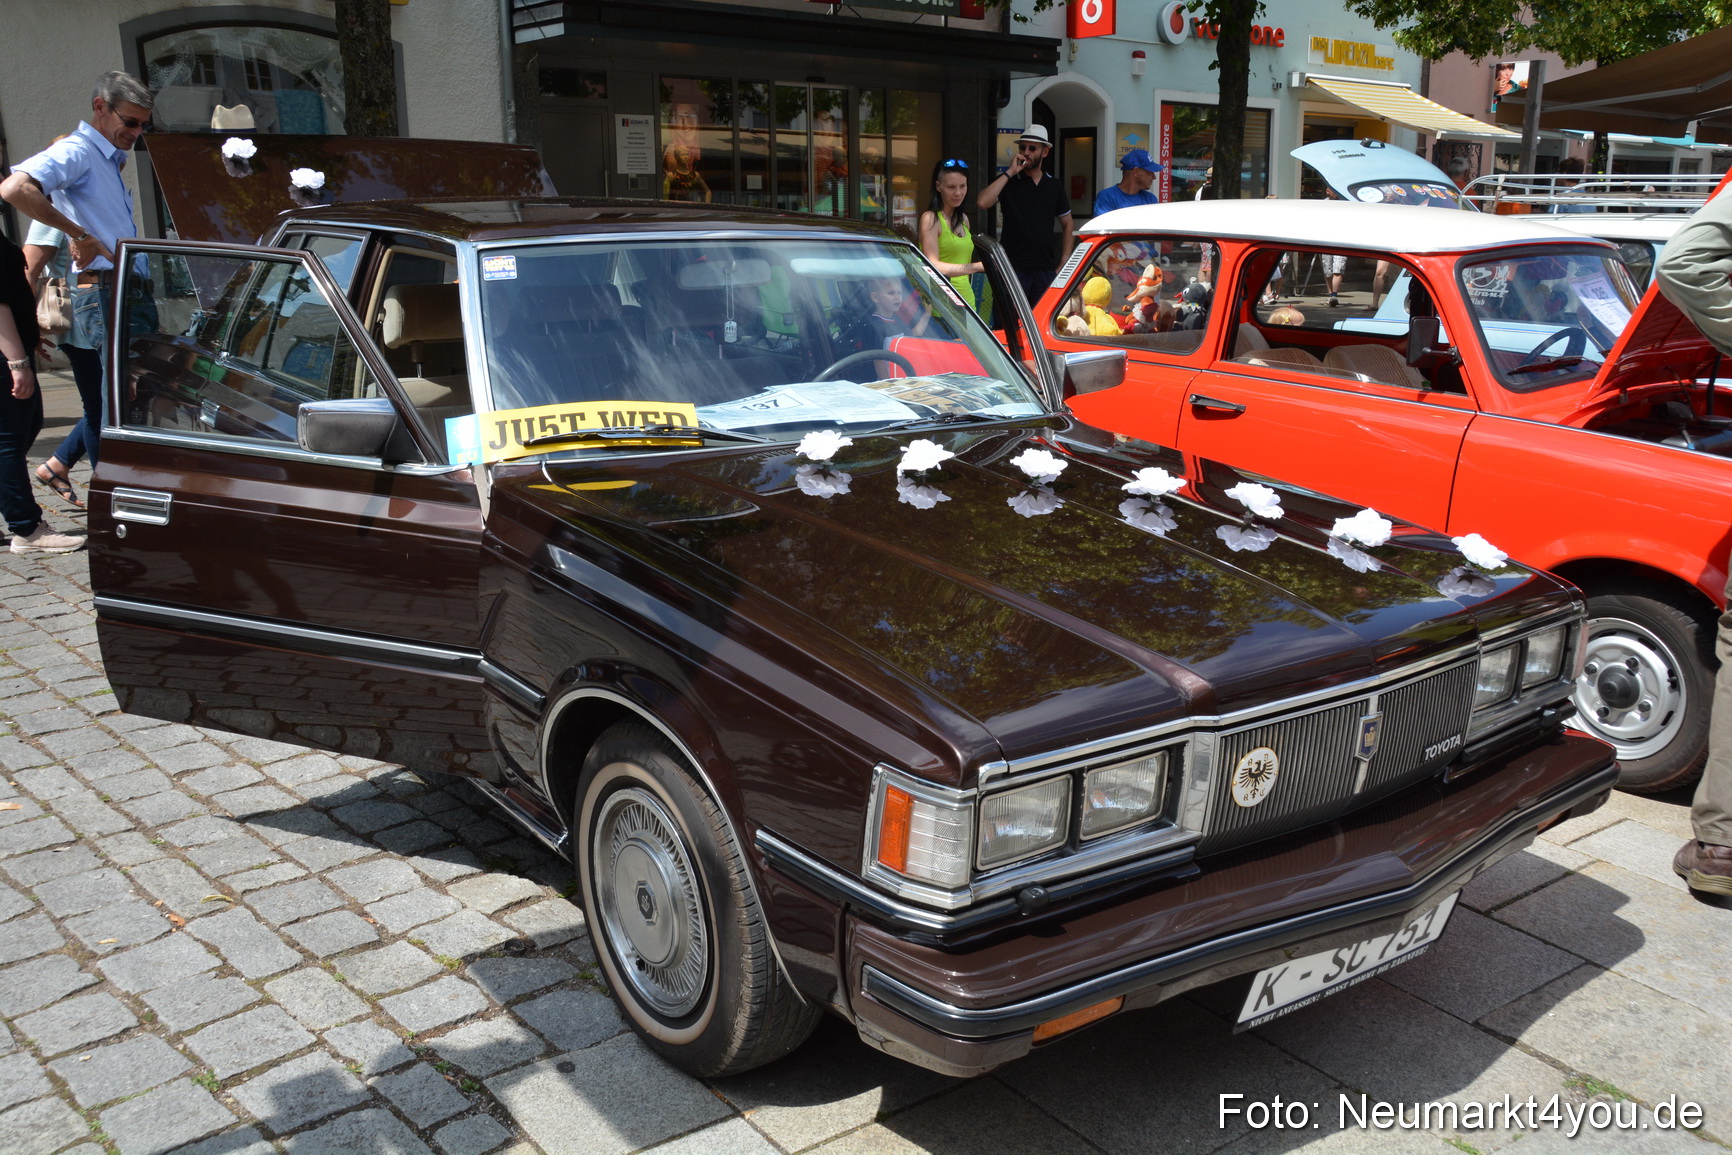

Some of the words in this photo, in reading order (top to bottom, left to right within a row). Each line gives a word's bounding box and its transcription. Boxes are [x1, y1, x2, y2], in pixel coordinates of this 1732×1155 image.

[1193, 17, 1285, 48] voone
[1161, 124, 1170, 157] Store
[740, 399, 780, 412] 137
[1424, 734, 1461, 761] TOYOTA
[1249, 1012, 1277, 1028] NICHT
[1323, 981, 1350, 998] SONST
[1350, 968, 1377, 986] KOMMT
[1253, 966, 1289, 1012] K
